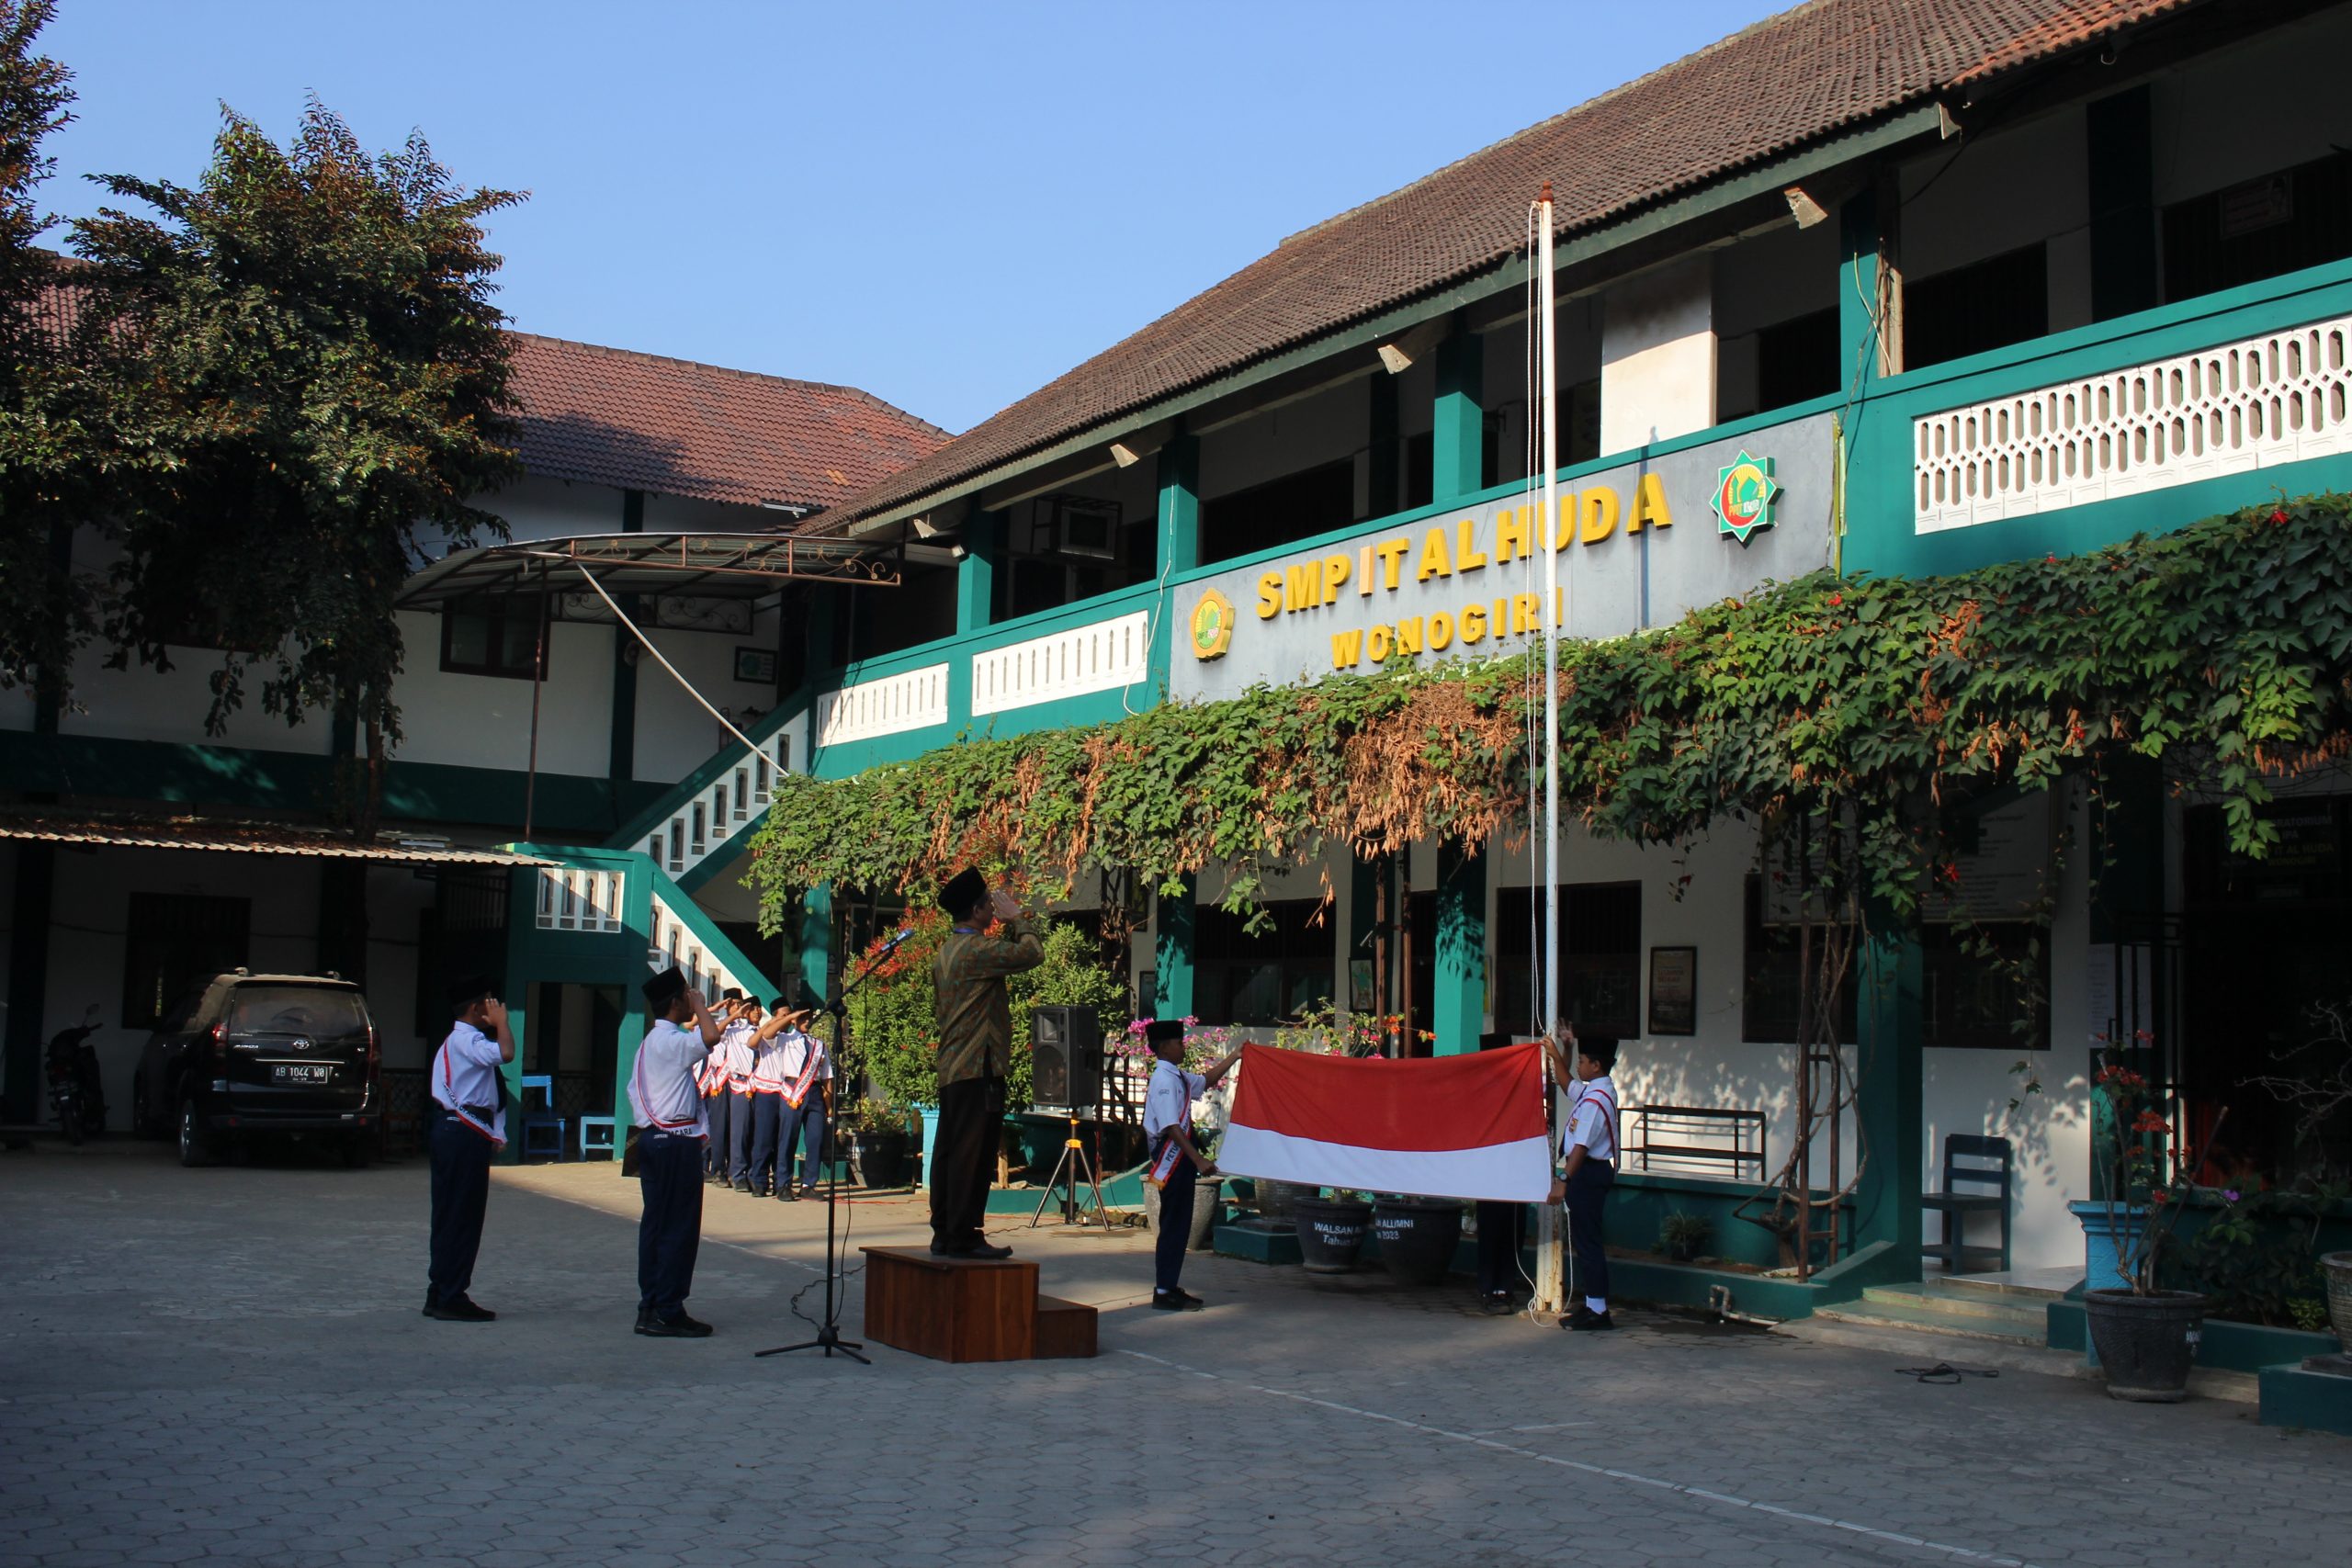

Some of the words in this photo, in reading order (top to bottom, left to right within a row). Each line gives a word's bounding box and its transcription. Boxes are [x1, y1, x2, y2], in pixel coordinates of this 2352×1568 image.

[1256, 554, 1351, 620] SMP
[1359, 537, 1409, 597] IT
[1417, 520, 1487, 583] AL
[1495, 473, 1672, 565] HUDA
[1331, 587, 1563, 671] WONOGIRI
[275, 1066, 286, 1077] AB
[289, 1066, 309, 1077] 1044
[1314, 1222, 1353, 1235] WALSAN
[1382, 1219, 1414, 1228] ALUMNI
